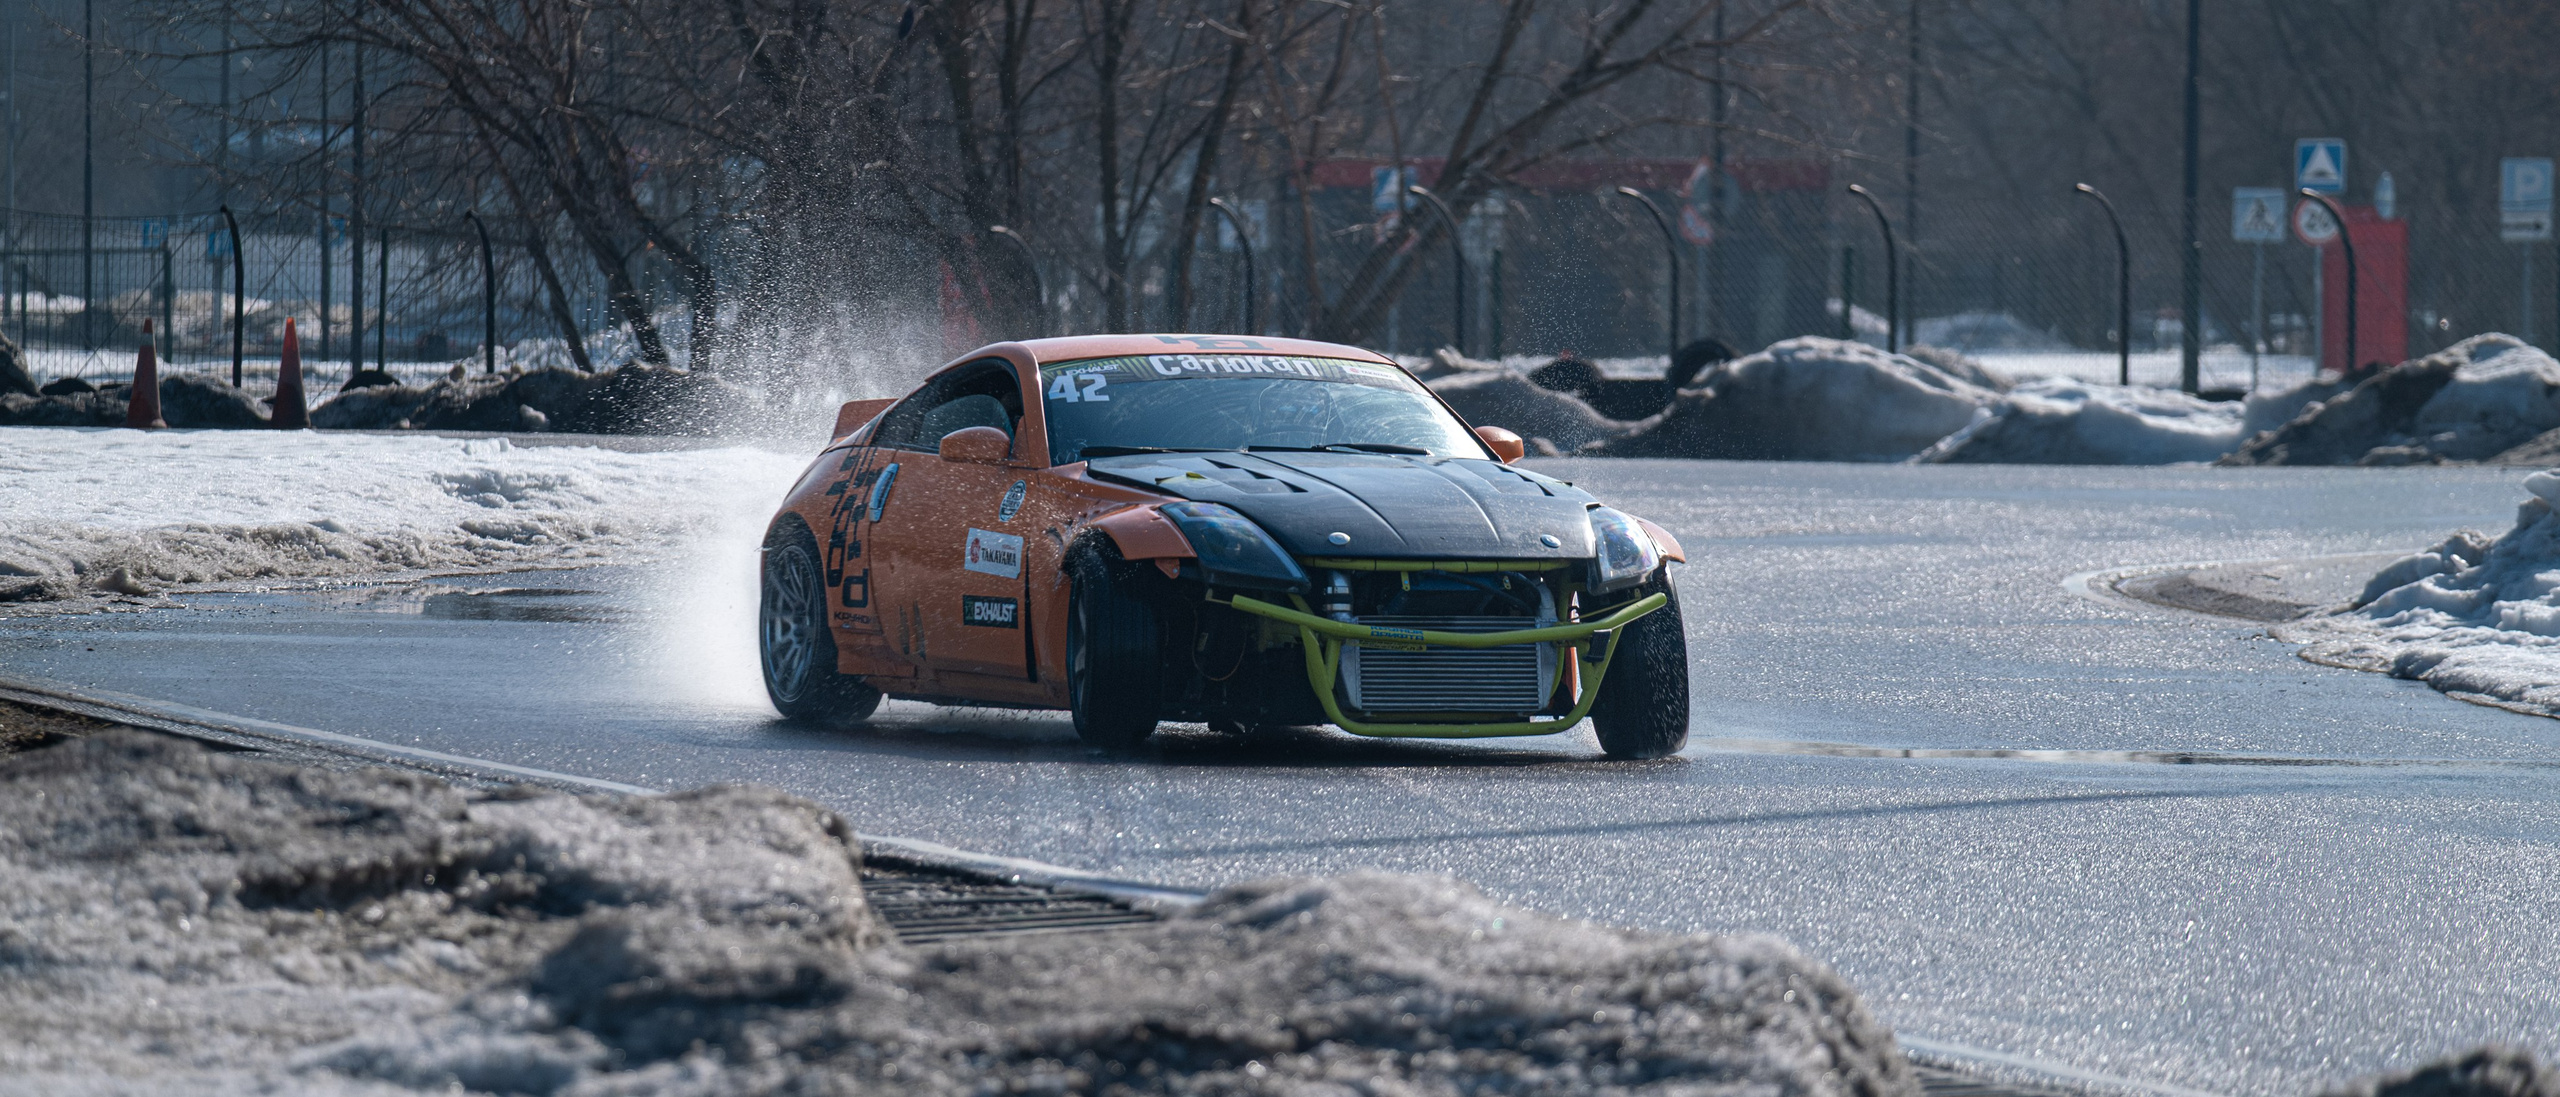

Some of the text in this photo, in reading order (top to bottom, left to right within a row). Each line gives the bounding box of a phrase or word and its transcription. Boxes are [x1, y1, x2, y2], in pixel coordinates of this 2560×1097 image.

[2514, 165, 2543, 201] P
[1048, 373, 1110, 402] 42
[981, 547, 1017, 567] TAKAYAMA
[974, 601, 1017, 623] EXHAUST
